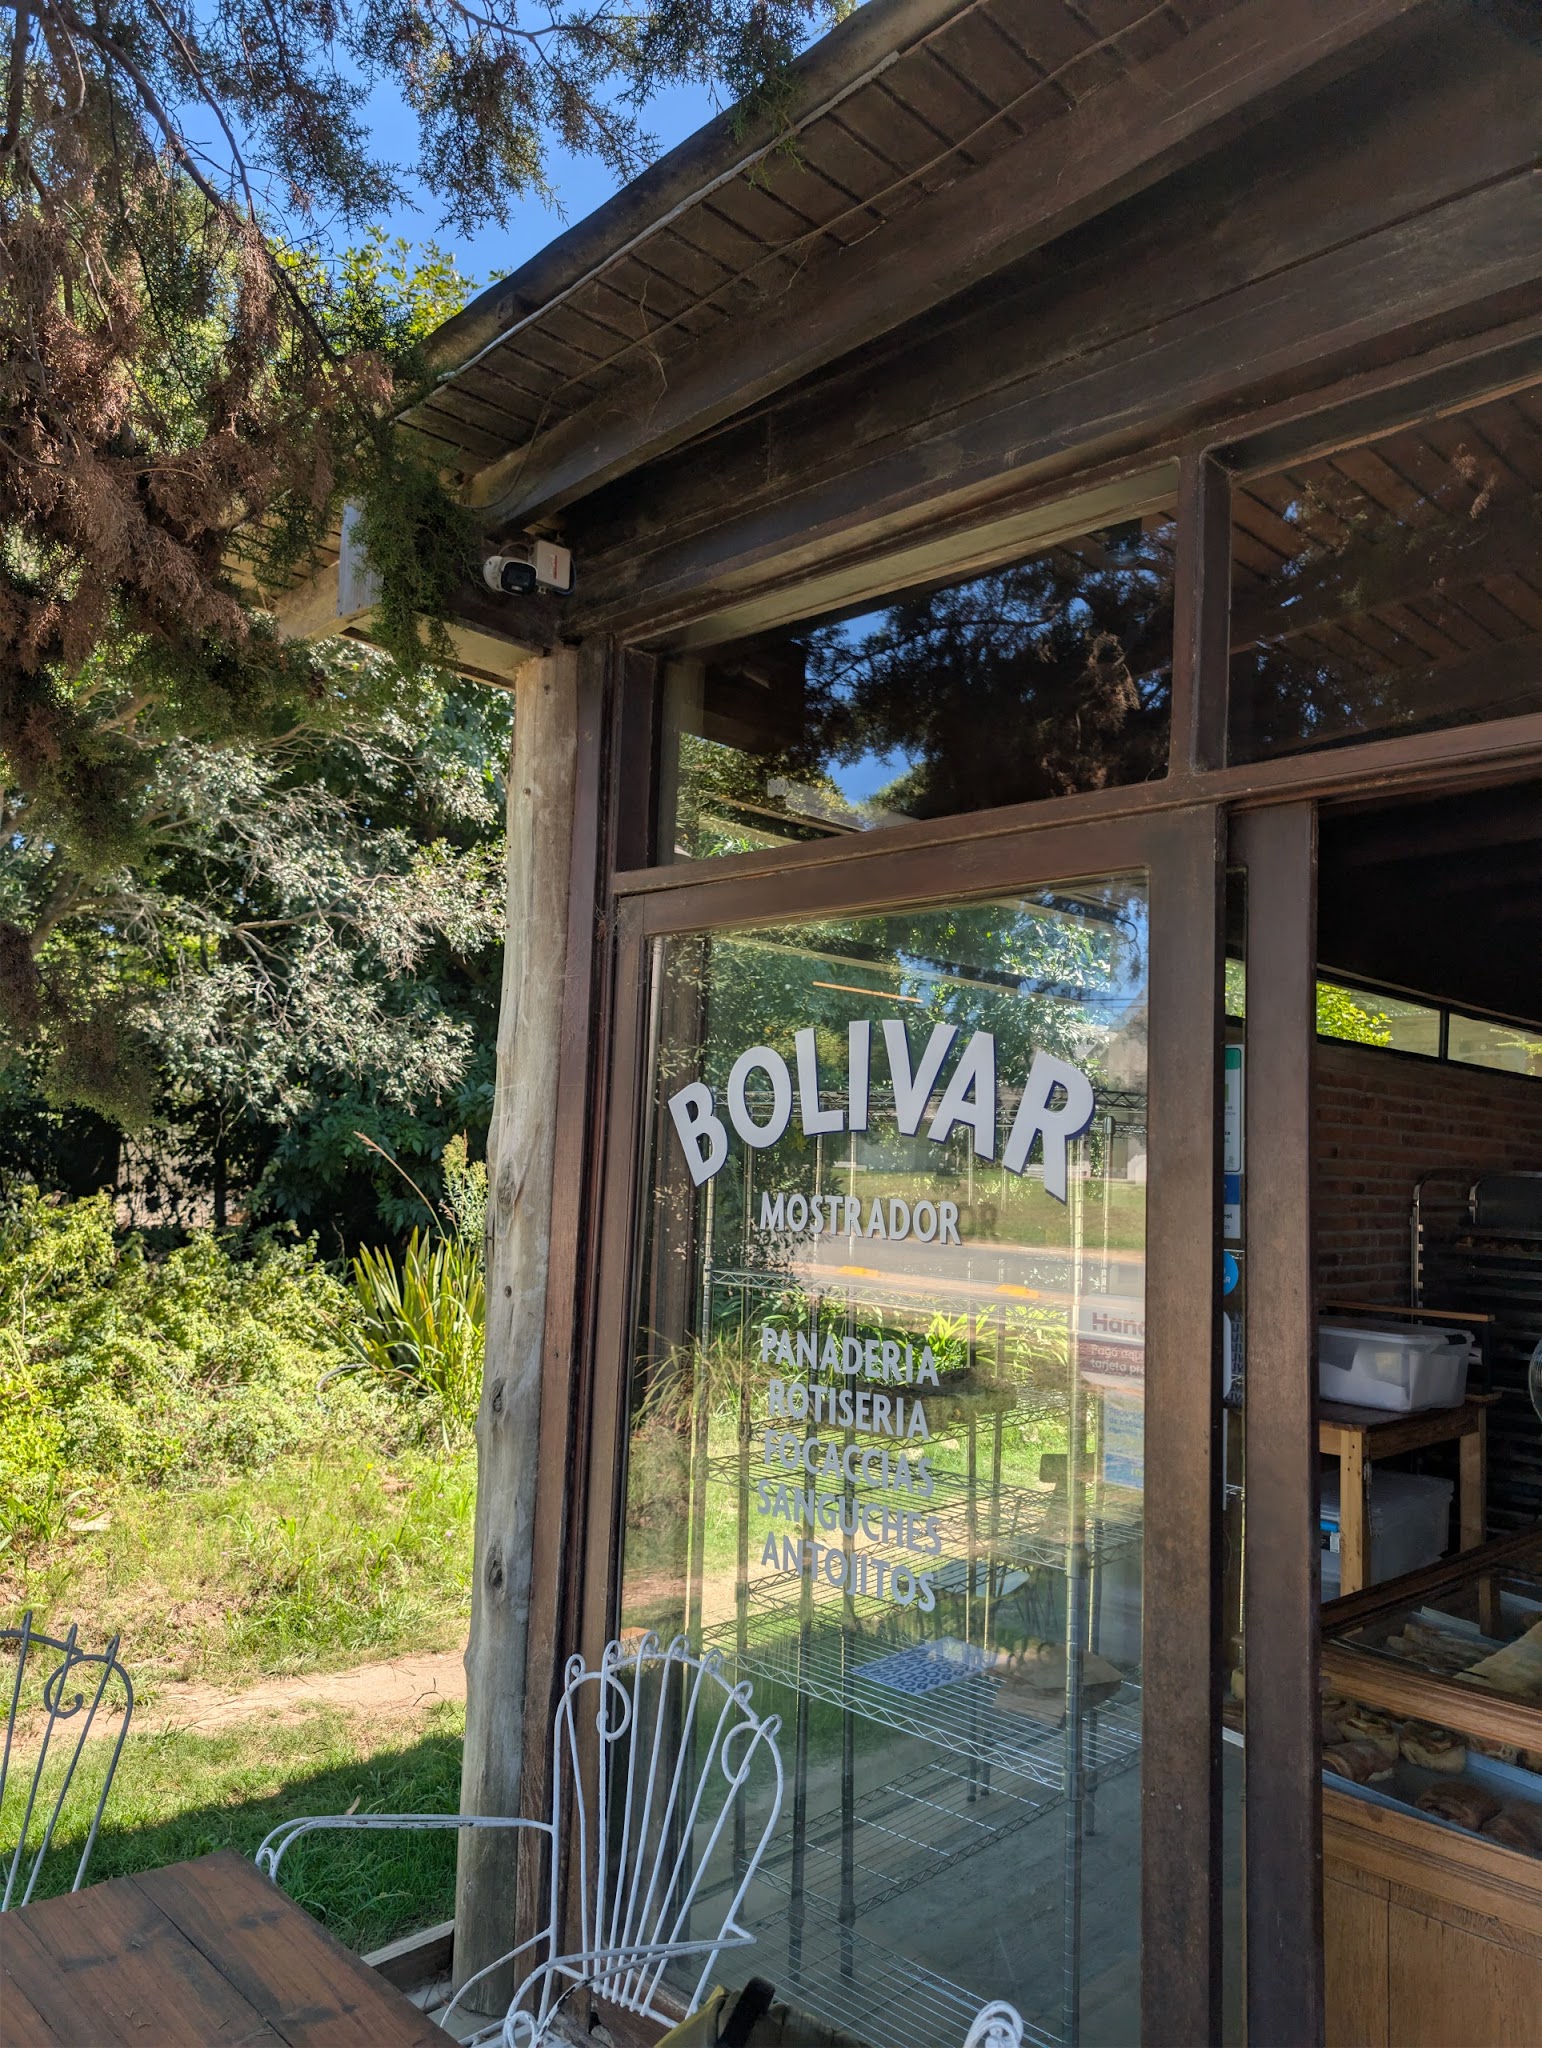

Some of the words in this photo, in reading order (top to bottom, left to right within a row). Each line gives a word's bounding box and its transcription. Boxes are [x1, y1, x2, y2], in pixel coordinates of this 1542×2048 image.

[667, 1019, 1096, 1204] BOLIVAR
[760, 1191, 962, 1245] MOSTRADOR
[761, 1327, 940, 1387] PANADERIA
[768, 1379, 930, 1440] ROTISERIA
[763, 1429, 935, 1497] FOCACCIAS
[757, 1479, 942, 1556] SANGUCHES
[761, 1531, 936, 1612] ANTOJITOS
